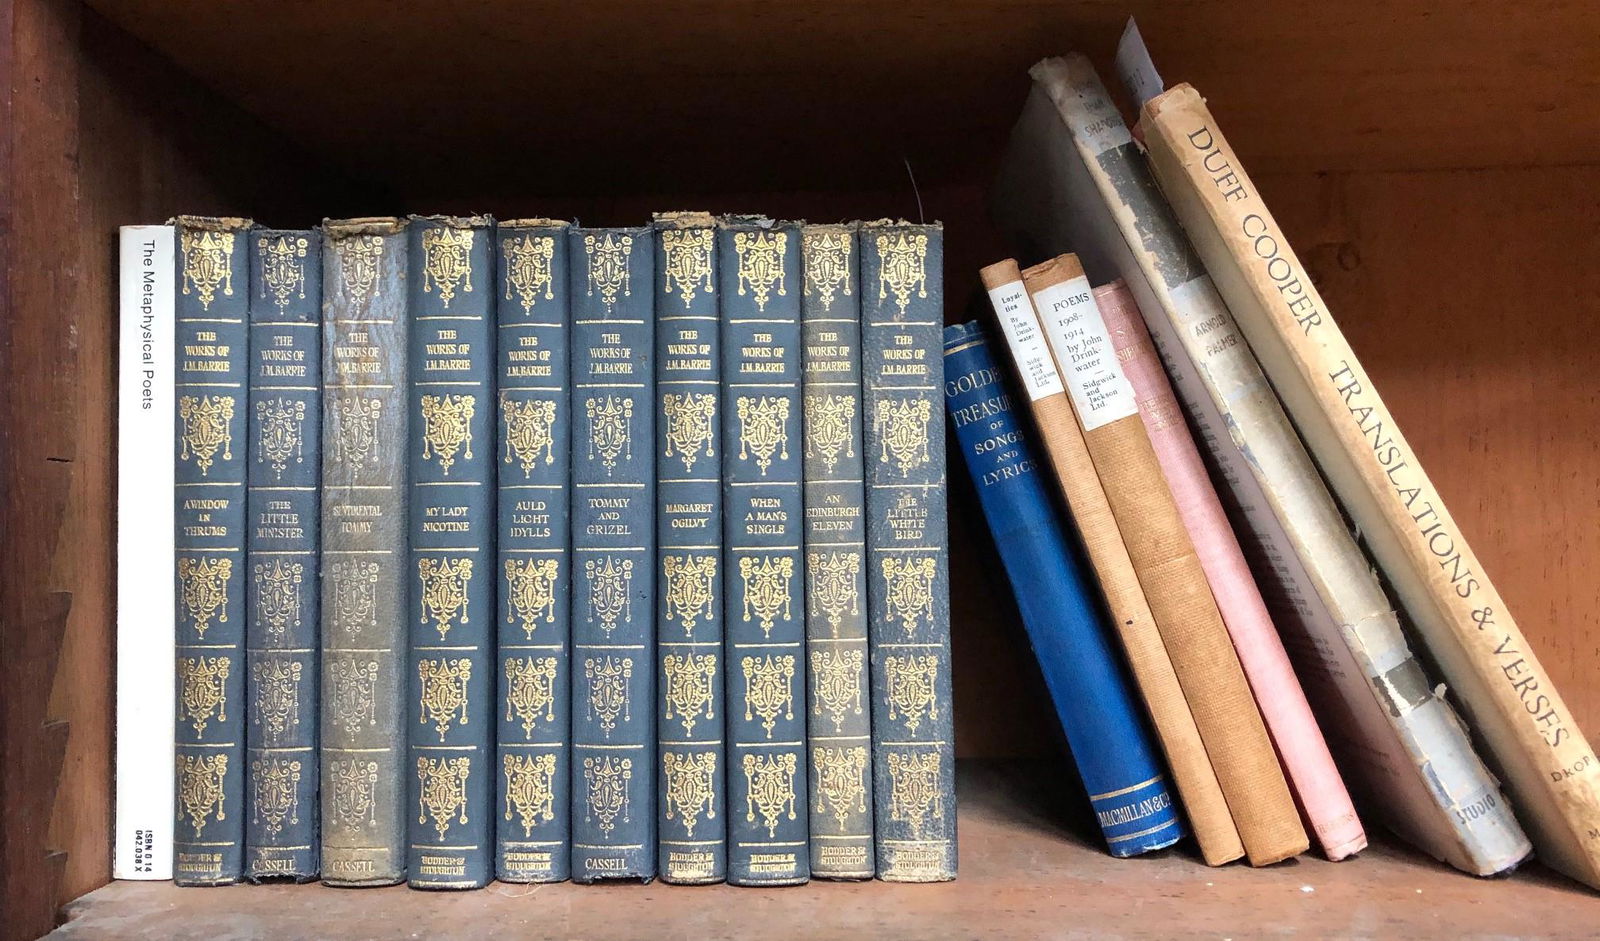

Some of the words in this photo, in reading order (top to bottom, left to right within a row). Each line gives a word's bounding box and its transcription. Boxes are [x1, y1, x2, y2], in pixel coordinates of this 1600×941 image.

[1187, 125, 1248, 202] DUFF
[1242, 214, 1322, 336] COOPER
[143, 240, 155, 266] The
[1053, 292, 1090, 312] POEMS
[140, 271, 155, 364] Metaphysical
[1195, 314, 1226, 337] ARNOLD
[196, 331, 217, 342] THE
[348, 332, 369, 343] THE
[438, 330, 457, 340] THE
[601, 333, 621, 344] THE
[679, 330, 698, 341] THE
[753, 333, 772, 343] THE
[819, 332, 838, 342] THE
[894, 335, 913, 345] THE
[1064, 328, 1084, 341] 1914
[273, 335, 294, 347] THE
[519, 336, 538, 347] THE
[1066, 344, 1081, 355] by
[1082, 335, 1103, 349] John
[184, 345, 216, 357] WORKS
[217, 346, 230, 357] OF
[336, 346, 367, 358] WORKS
[367, 346, 380, 358] OF
[426, 344, 457, 355] WORKS
[458, 344, 470, 355] OF
[589, 347, 620, 359] WORKS
[620, 347, 632, 359] OF
[667, 344, 697, 355] WORKS
[699, 344, 711, 355] OF
[741, 347, 772, 358] WORKS
[773, 347, 785, 358] OF
[807, 346, 837, 357] WORKS
[839, 346, 850, 357] OF
[882, 349, 913, 360] WORKS
[914, 348, 926, 360] OF
[260, 350, 292, 361] WORKS
[293, 350, 305, 361] OF
[508, 351, 537, 362] WORKS
[539, 350, 551, 361] OF
[1075, 358, 1101, 373] water
[944, 367, 1003, 398] GOLDE
[1082, 372, 1117, 390] Sidgwick
[142, 370, 154, 410] Poets
[1086, 387, 1100, 397] and
[1089, 389, 1119, 404] Jackson
[990, 420, 1004, 430] OF
[974, 429, 1024, 455] SONGS
[996, 450, 1019, 463] AND
[983, 459, 1038, 487] LYRICS
[588, 498, 630, 509] TOMMY
[750, 498, 780, 508] WHEN
[825, 494, 840, 503] AN
[269, 501, 291, 510] THE
[515, 501, 546, 511] AULD
[665, 503, 713, 514] MARGARET
[426, 506, 441, 517] MY
[442, 506, 469, 517] LADY
[598, 512, 620, 521] AND
[744, 512, 754, 521] A
[756, 511, 788, 521] MAN'S
[806, 507, 860, 518] EDINBURGH
[198, 513, 211, 522] IN
[261, 513, 299, 524] LITTLE
[423, 521, 470, 532] NICOTINE
[671, 518, 709, 529] OGILVY
[812, 521, 854, 531] ELEVEN
[889, 519, 925, 529] WHITE
[184, 526, 227, 537] THRUMS
[256, 527, 304, 539] MINISTER
[510, 527, 551, 538] IDYLLS
[586, 524, 632, 536] GRIZEL
[746, 524, 785, 535] SINGLE
[894, 529, 923, 540] BIRD
[1328, 360, 1480, 599] TRANSLATIONS
[1471, 607, 1495, 630] &
[1493, 635, 1569, 748] VERSES
[1456, 793, 1496, 825] STUDIO
[145, 830, 153, 850] ISBN
[252, 859, 296, 871] CSSELL
[333, 861, 375, 872] CASSELL
[585, 858, 628, 870] CASSELL
